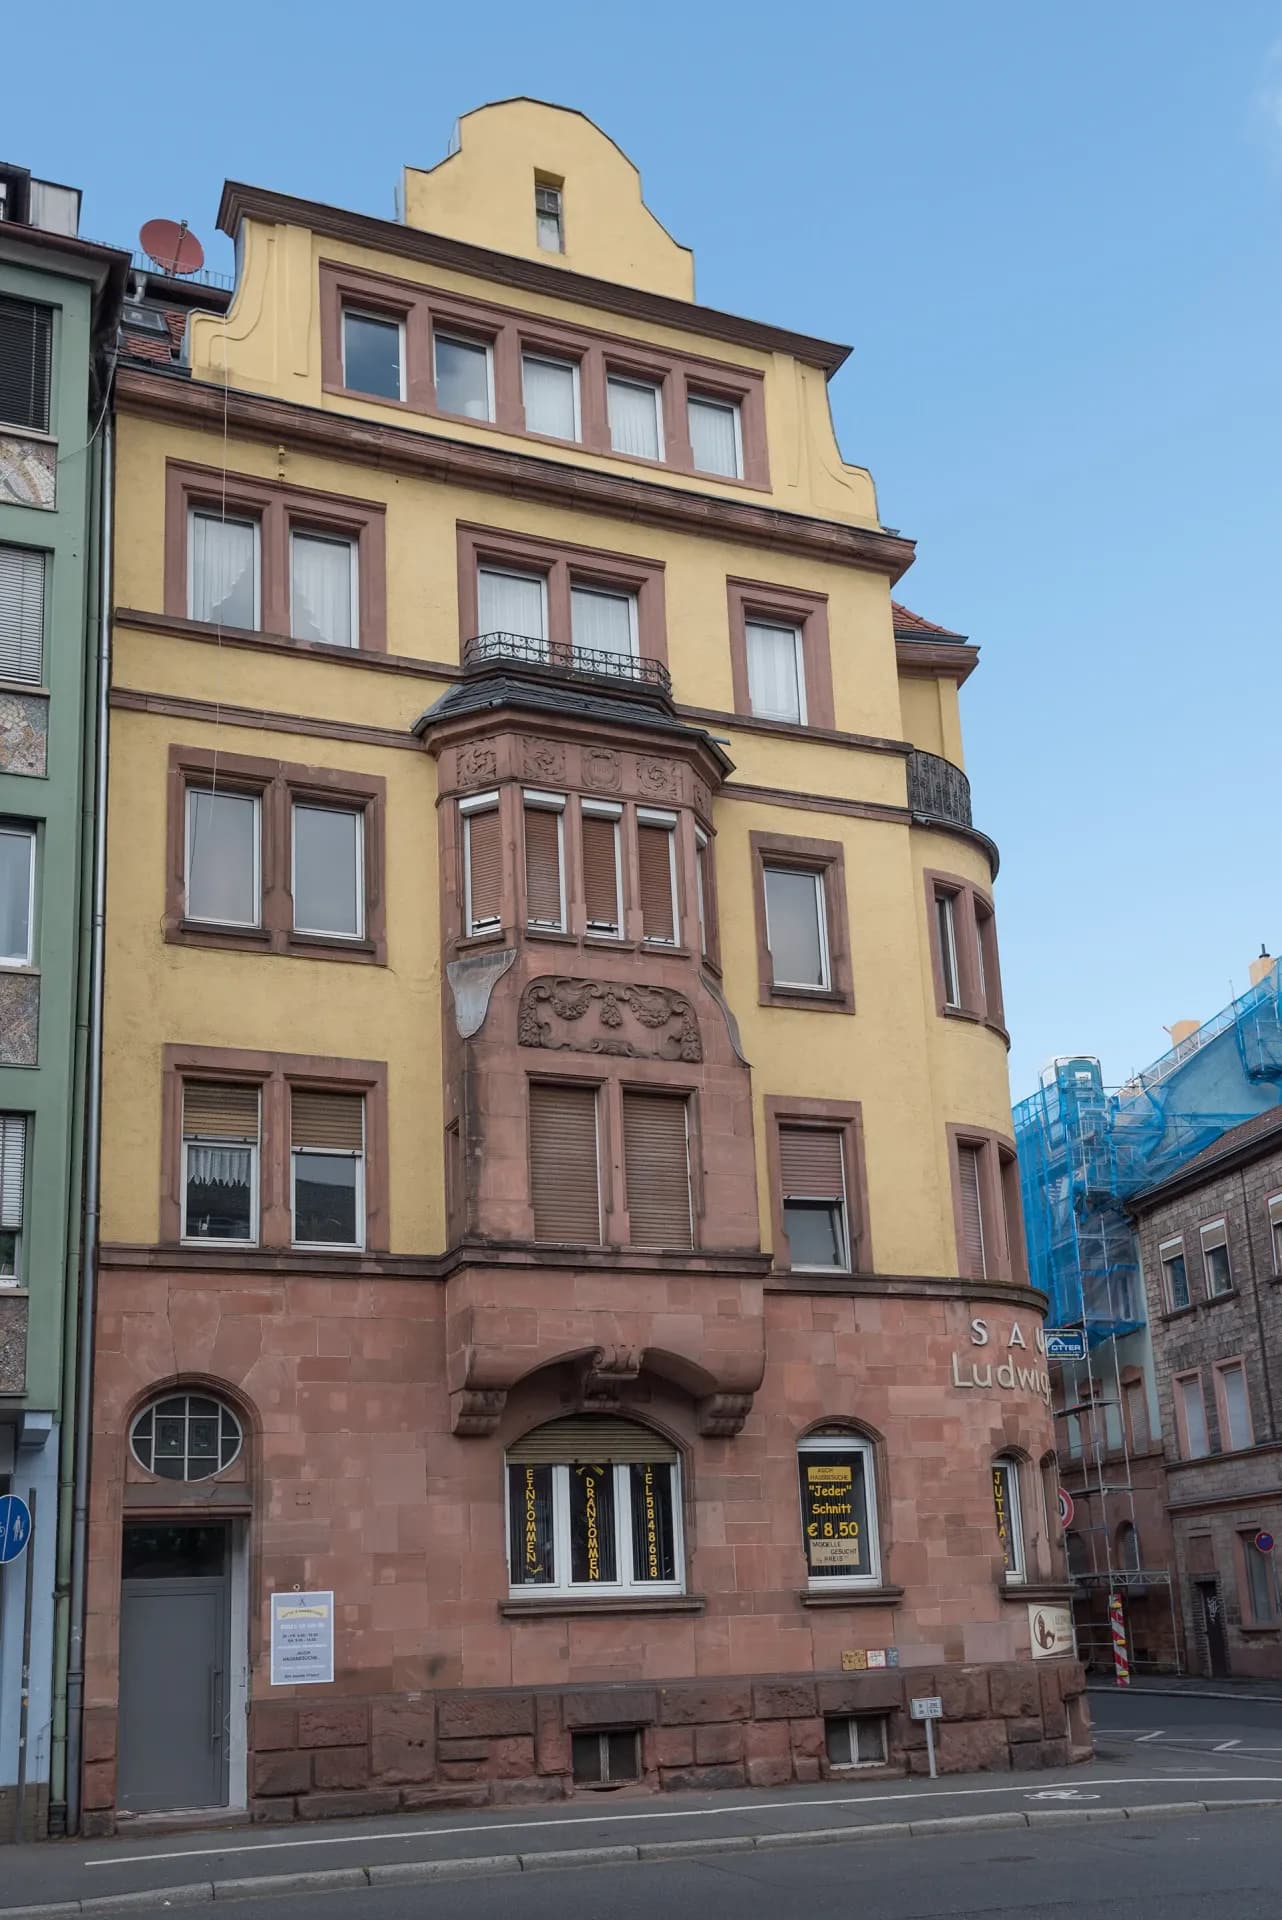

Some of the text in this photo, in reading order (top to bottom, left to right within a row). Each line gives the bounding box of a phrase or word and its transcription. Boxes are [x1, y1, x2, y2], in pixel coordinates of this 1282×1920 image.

[526, 1464, 537, 1562] EINKOMMEN
[586, 1477, 599, 1579] DRANKOMMEN
[812, 1503, 852, 1514] Schnitt
[824, 1521, 859, 1539] 8,50
